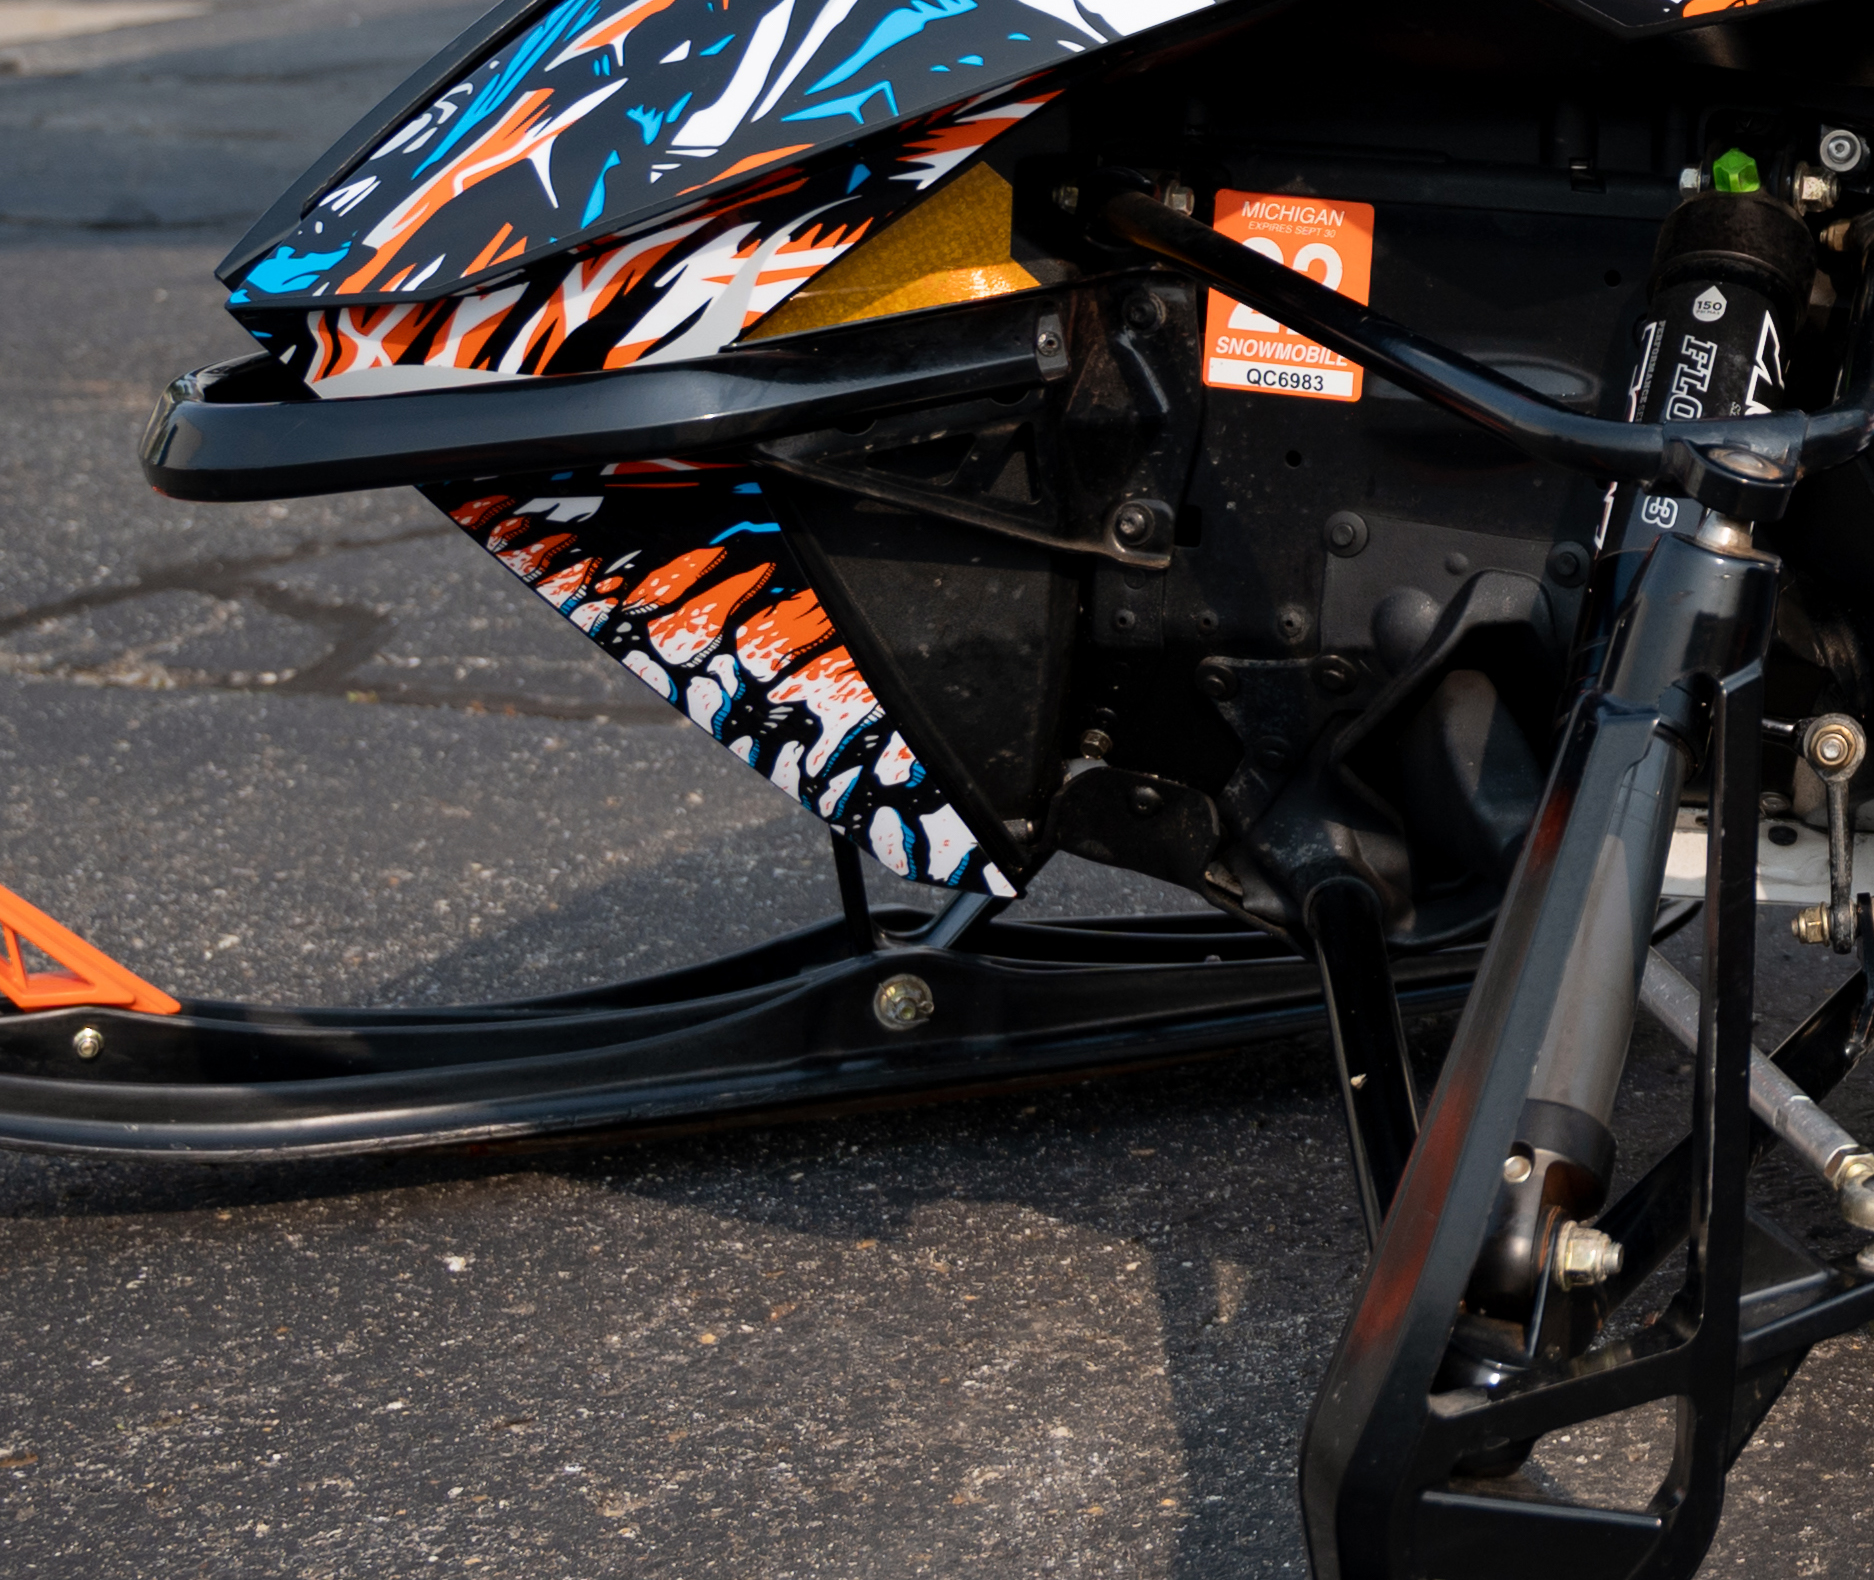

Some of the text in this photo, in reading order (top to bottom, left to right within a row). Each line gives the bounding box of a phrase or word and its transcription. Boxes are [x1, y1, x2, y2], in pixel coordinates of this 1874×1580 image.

[1242, 201, 1345, 226] MICHIGAN
[1248, 221, 1337, 238] EXPIRES SEPT 30
[1697, 300, 1723, 311] 150
[1216, 336, 1348, 367] SNOWMOBILE
[1640, 320, 1667, 403] PERFORMANCE
[1246, 368, 1324, 392] QC6983
[1666, 334, 1718, 420] FLO
